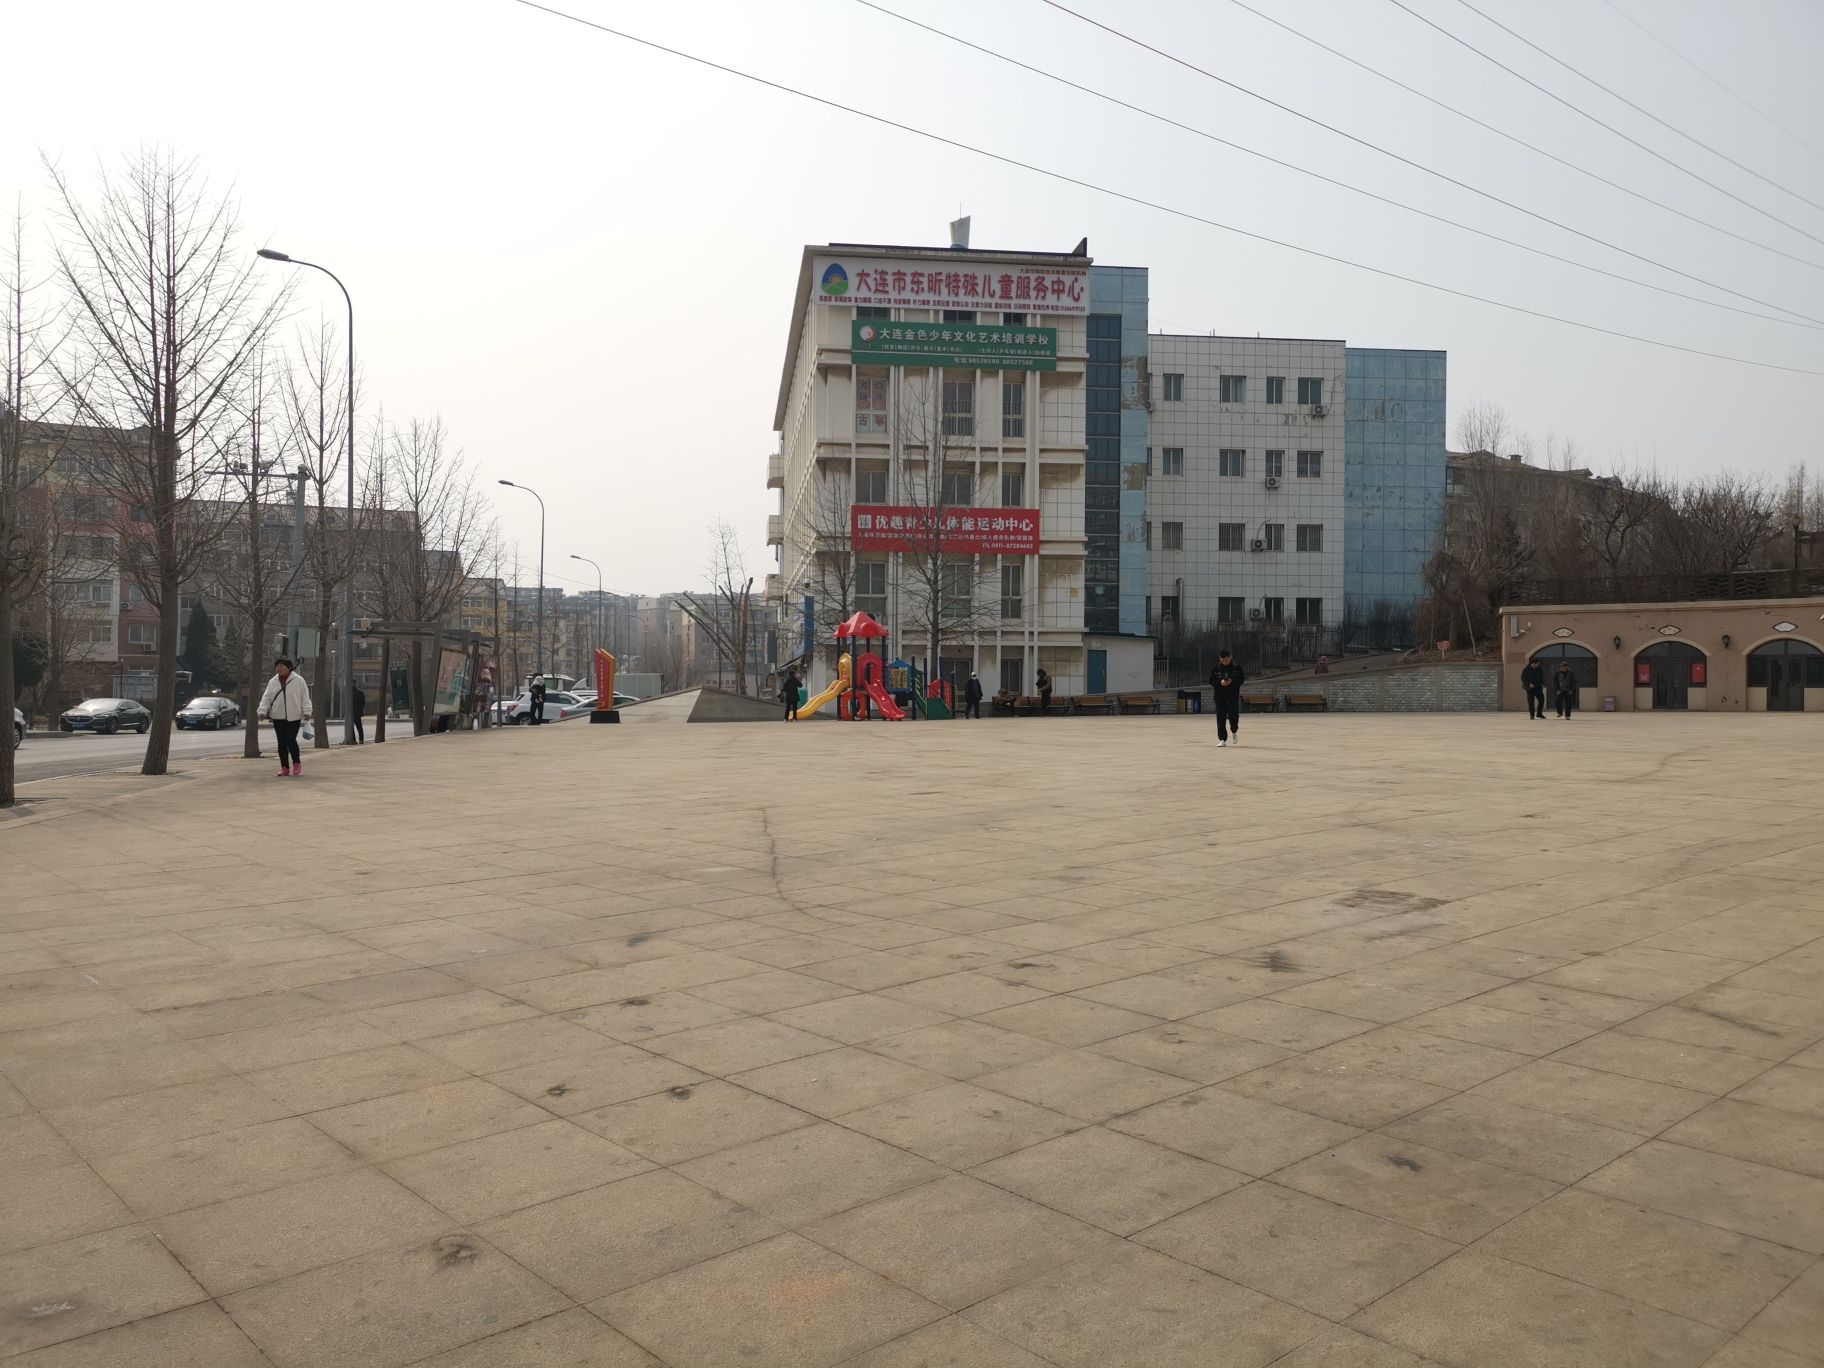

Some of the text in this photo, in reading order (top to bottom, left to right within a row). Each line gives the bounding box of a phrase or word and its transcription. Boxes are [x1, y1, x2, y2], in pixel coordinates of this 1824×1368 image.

[856, 268, 1085, 303] 大连市东昕特殊儿童服务中心
[880, 327, 1049, 345] 大连金色少年文化艺术培训学校
